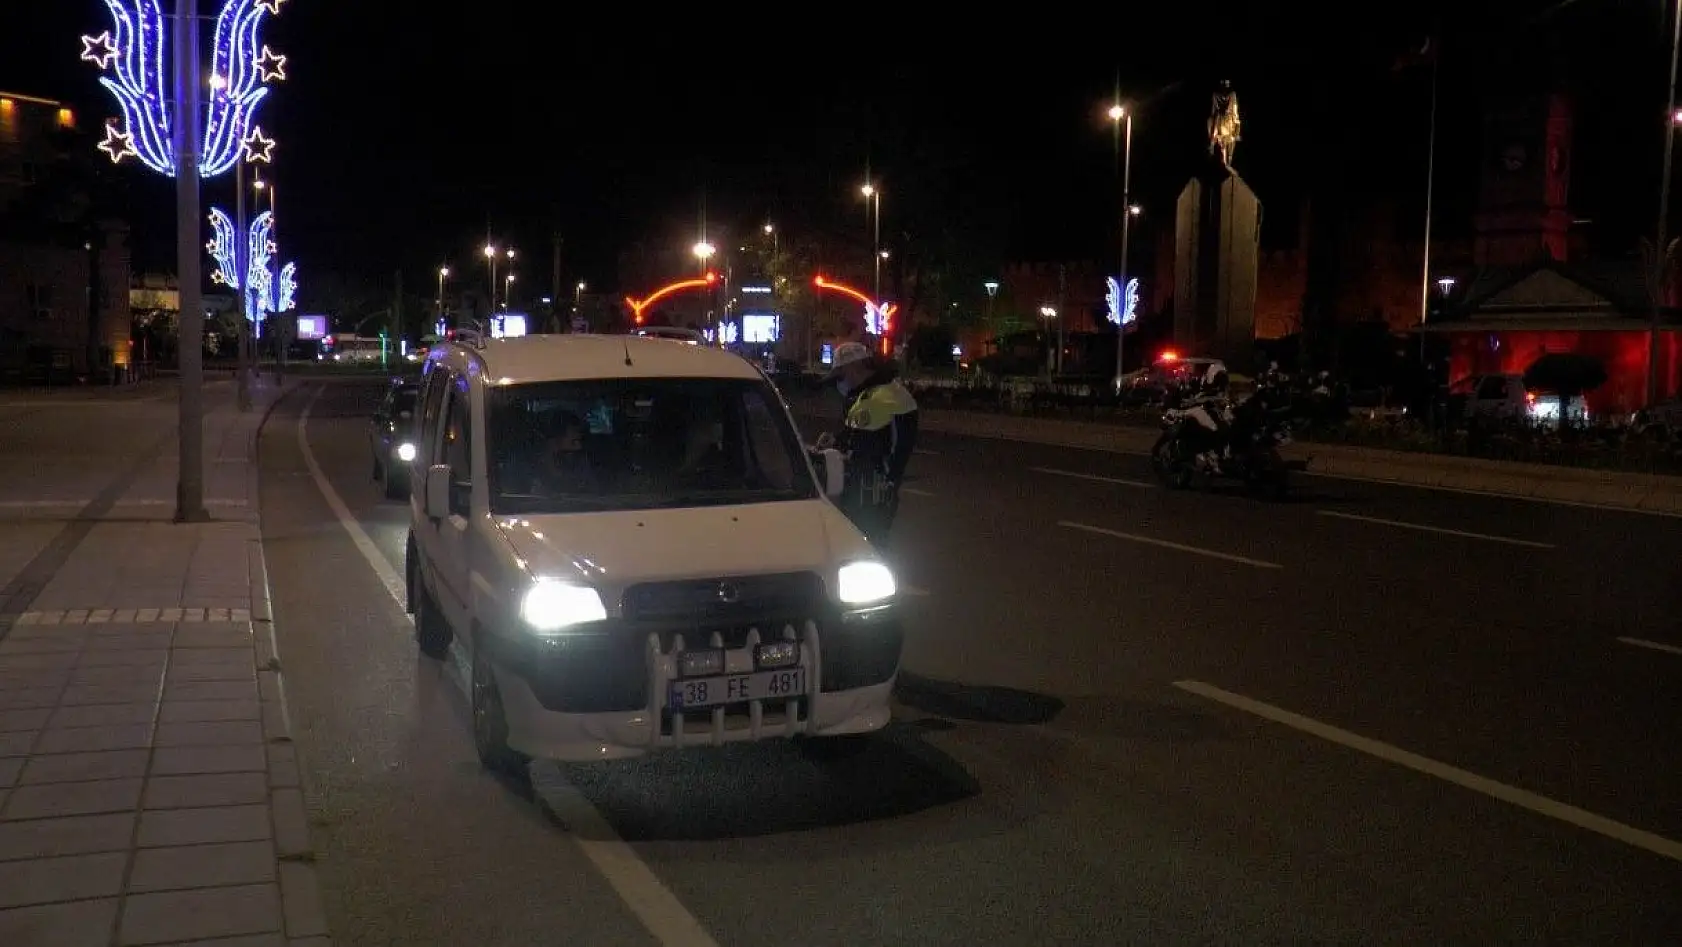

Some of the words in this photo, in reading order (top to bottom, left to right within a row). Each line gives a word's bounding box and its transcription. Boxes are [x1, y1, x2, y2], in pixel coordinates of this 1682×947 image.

[686, 681, 708, 704] 38
[727, 677, 749, 698] FE
[769, 672, 798, 694] 481
